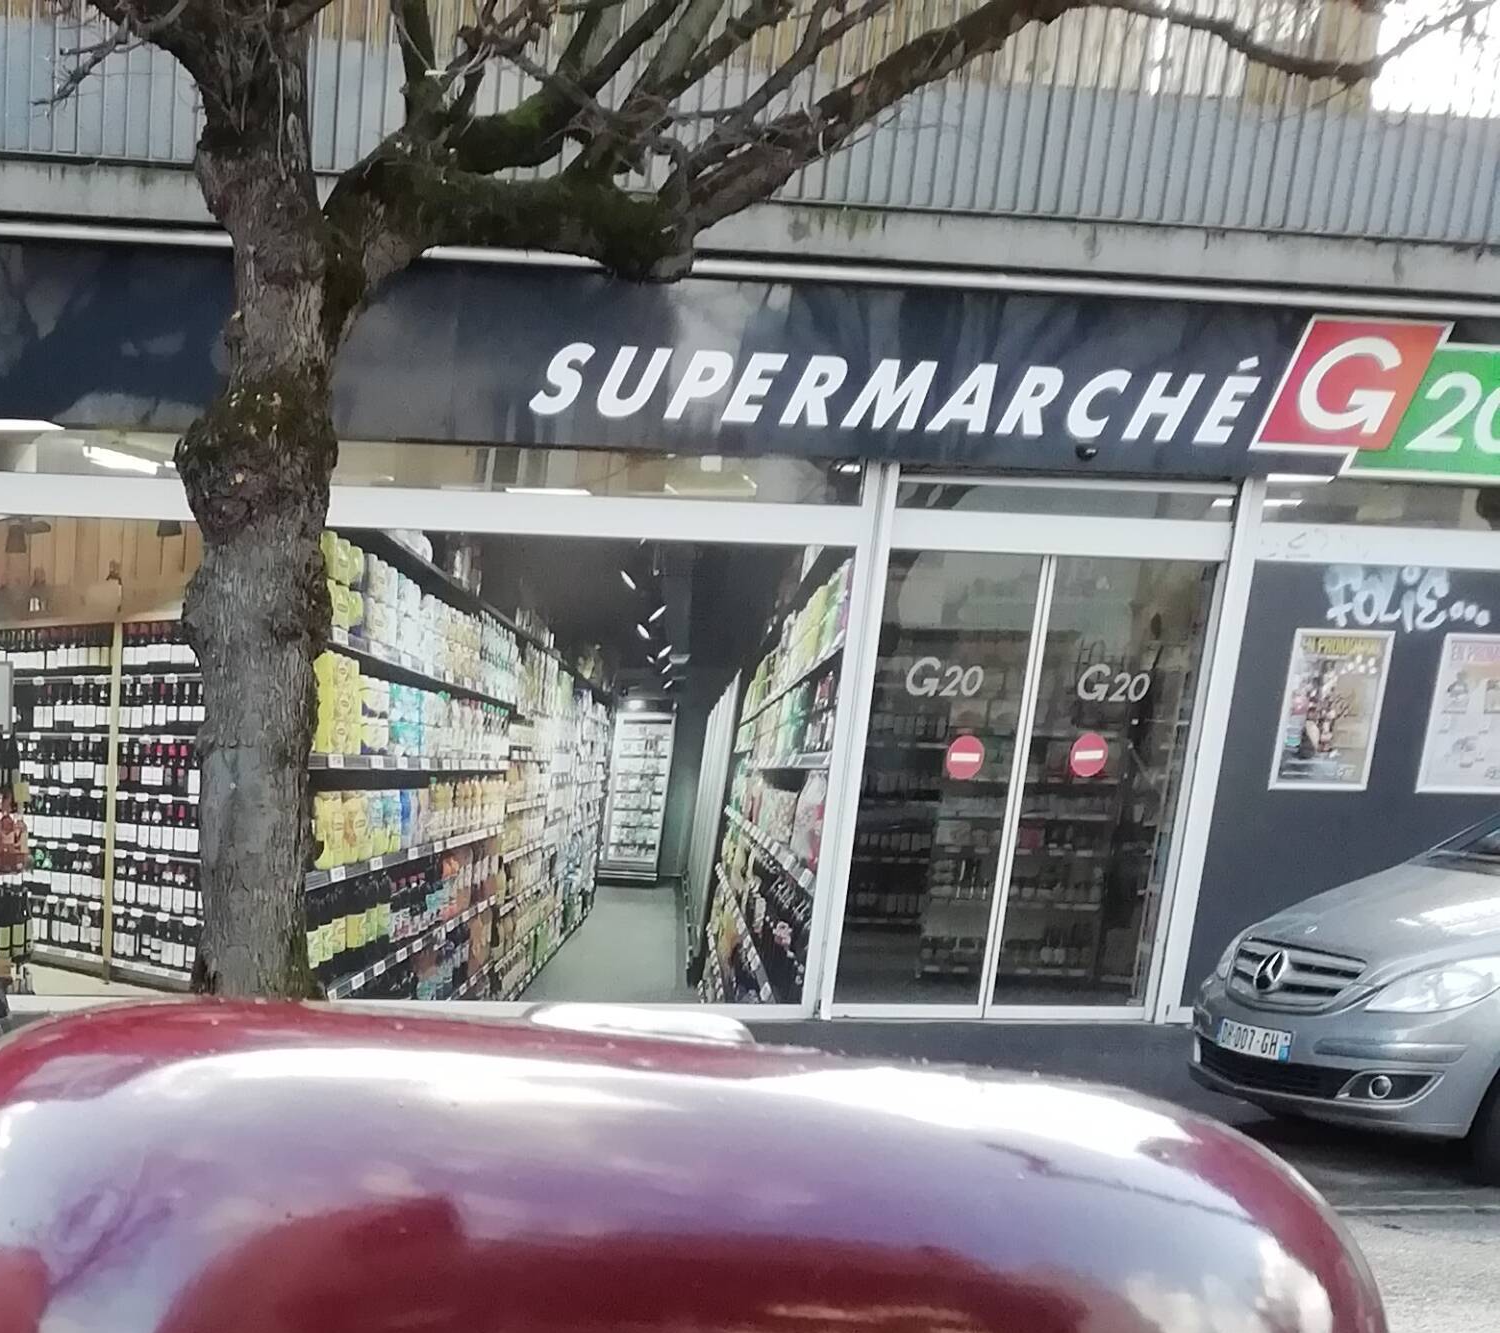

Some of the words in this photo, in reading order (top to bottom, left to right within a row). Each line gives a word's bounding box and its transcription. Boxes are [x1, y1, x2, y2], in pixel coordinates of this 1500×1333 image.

[528, 341, 1262, 445] SUPERMARCHÉ
[906, 656, 984, 697] G20
[1077, 664, 1150, 701] G20
